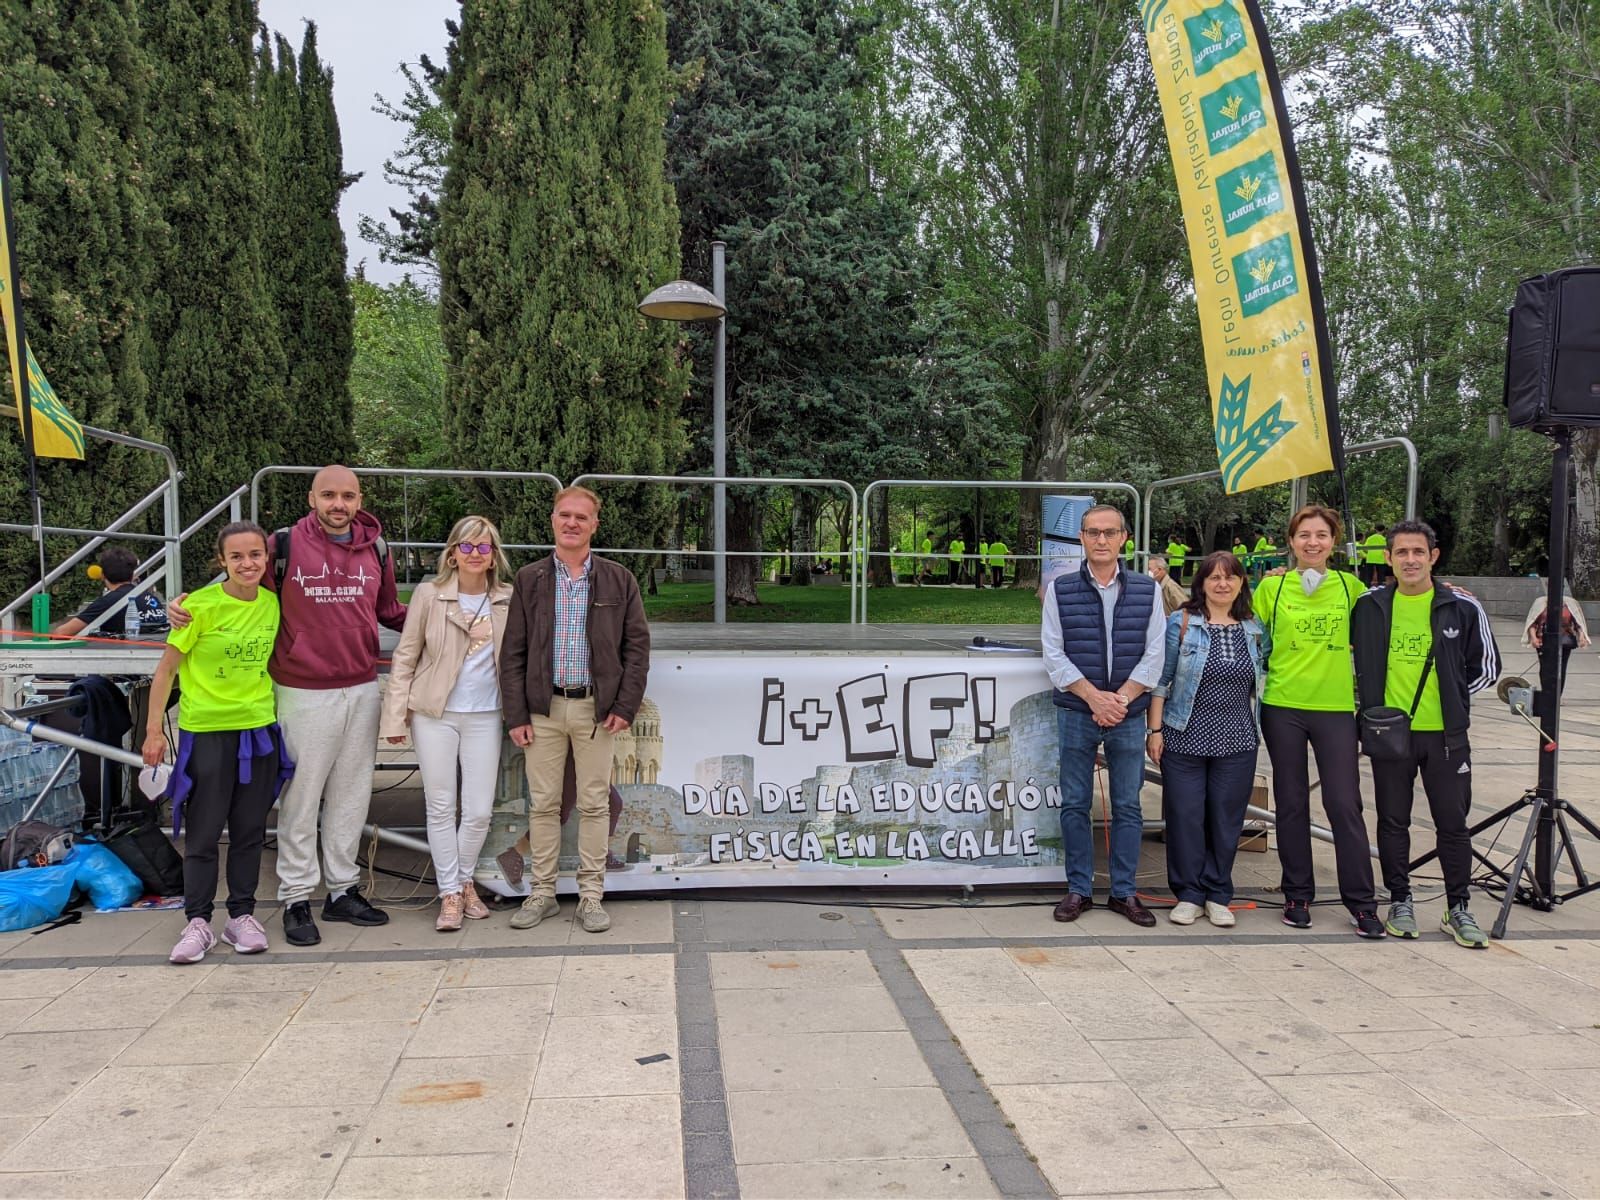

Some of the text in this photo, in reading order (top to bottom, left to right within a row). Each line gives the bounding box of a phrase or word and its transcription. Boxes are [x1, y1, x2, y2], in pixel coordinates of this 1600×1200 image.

[304, 587, 364, 596] MEDCINA
[682, 776, 1062, 816] DÍA DE LA EDUCACIÓN
[709, 826, 1039, 864] FÍSICA EN LA CALLE
